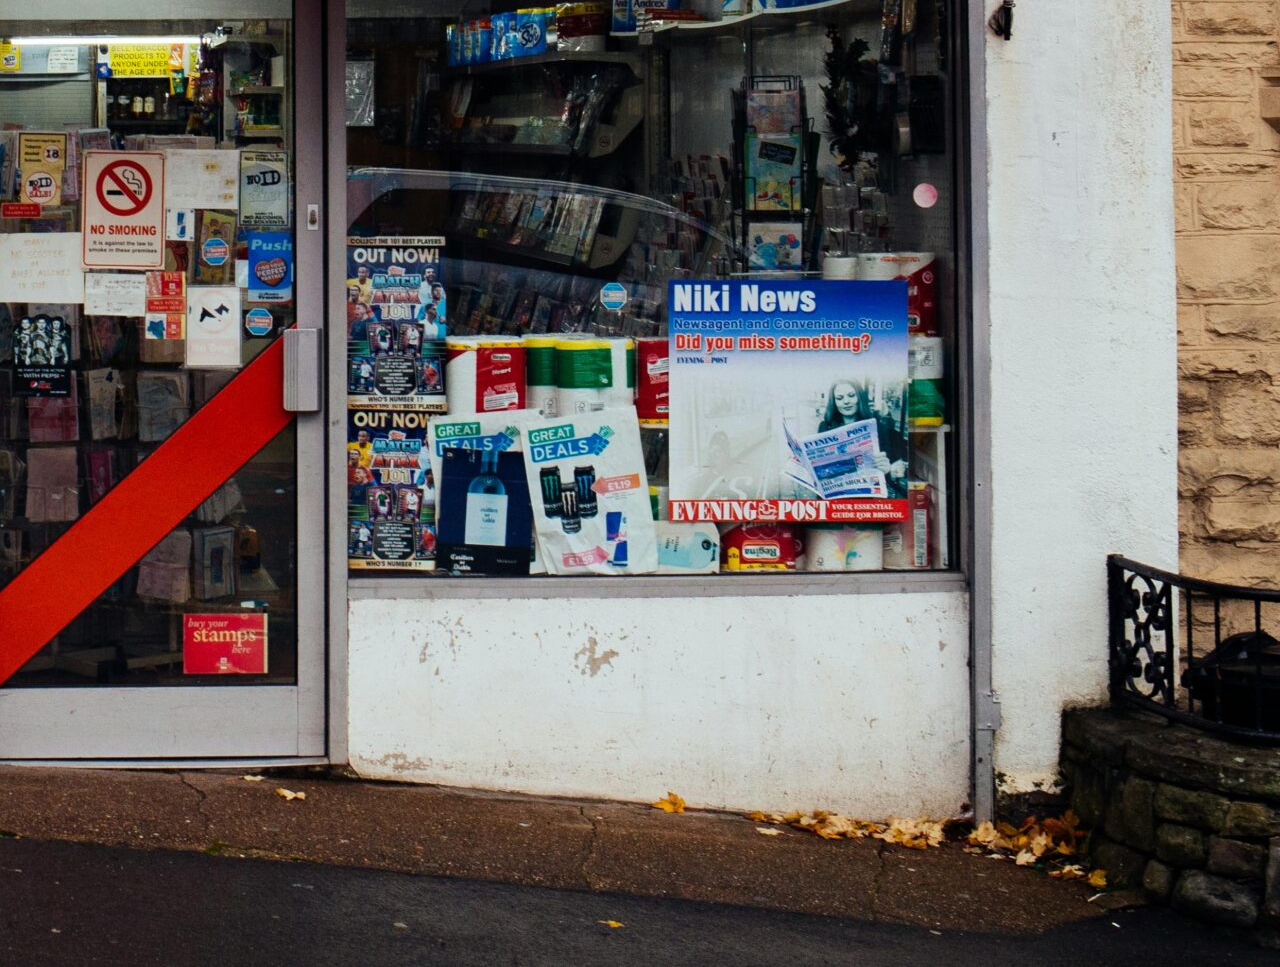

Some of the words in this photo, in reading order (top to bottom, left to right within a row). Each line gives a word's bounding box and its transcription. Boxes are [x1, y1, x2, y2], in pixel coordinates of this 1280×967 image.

[46, 149, 59, 159] 18
[90, 225, 105, 235] NO
[108, 224, 157, 236] SMOKING
[251, 239, 293, 251] Push
[353, 248, 387, 263] OUT
[391, 248, 440, 263] NOW!
[257, 265, 287, 277] PERFECT
[373, 276, 421, 287] MATCH
[372, 290, 422, 304] ATTAX
[674, 284, 730, 312] Niki
[740, 284, 817, 312] News
[381, 305, 412, 319] 101
[674, 318, 744, 332] Newsagent
[746, 318, 770, 329] and
[773, 318, 855, 329] Convenience
[859, 318, 893, 329] Store
[675, 335, 701, 349] Did
[706, 335, 734, 352] you
[739, 335, 775, 349] miss
[779, 334, 871, 353] something?
[353, 412, 389, 427] OUT
[392, 412, 429, 428] NOW
[437, 424, 478, 437] GREAT
[531, 426, 571, 442] GREAT
[804, 434, 839, 449] EVENING
[846, 425, 868, 438] POST
[373, 439, 420, 451] MATCH
[533, 440, 589, 461] DEALS
[371, 455, 421, 468] ATTAX
[382, 469, 410, 483] 101
[607, 480, 631, 491] £1.19
[671, 500, 758, 520] EVENING
[777, 500, 830, 521] POST
[854, 503, 893, 511] ESSENTIAL
[188, 618, 206, 630] buy
[207, 620, 229, 630] your
[193, 628, 256, 647] stamps
[231, 644, 251, 654] here
